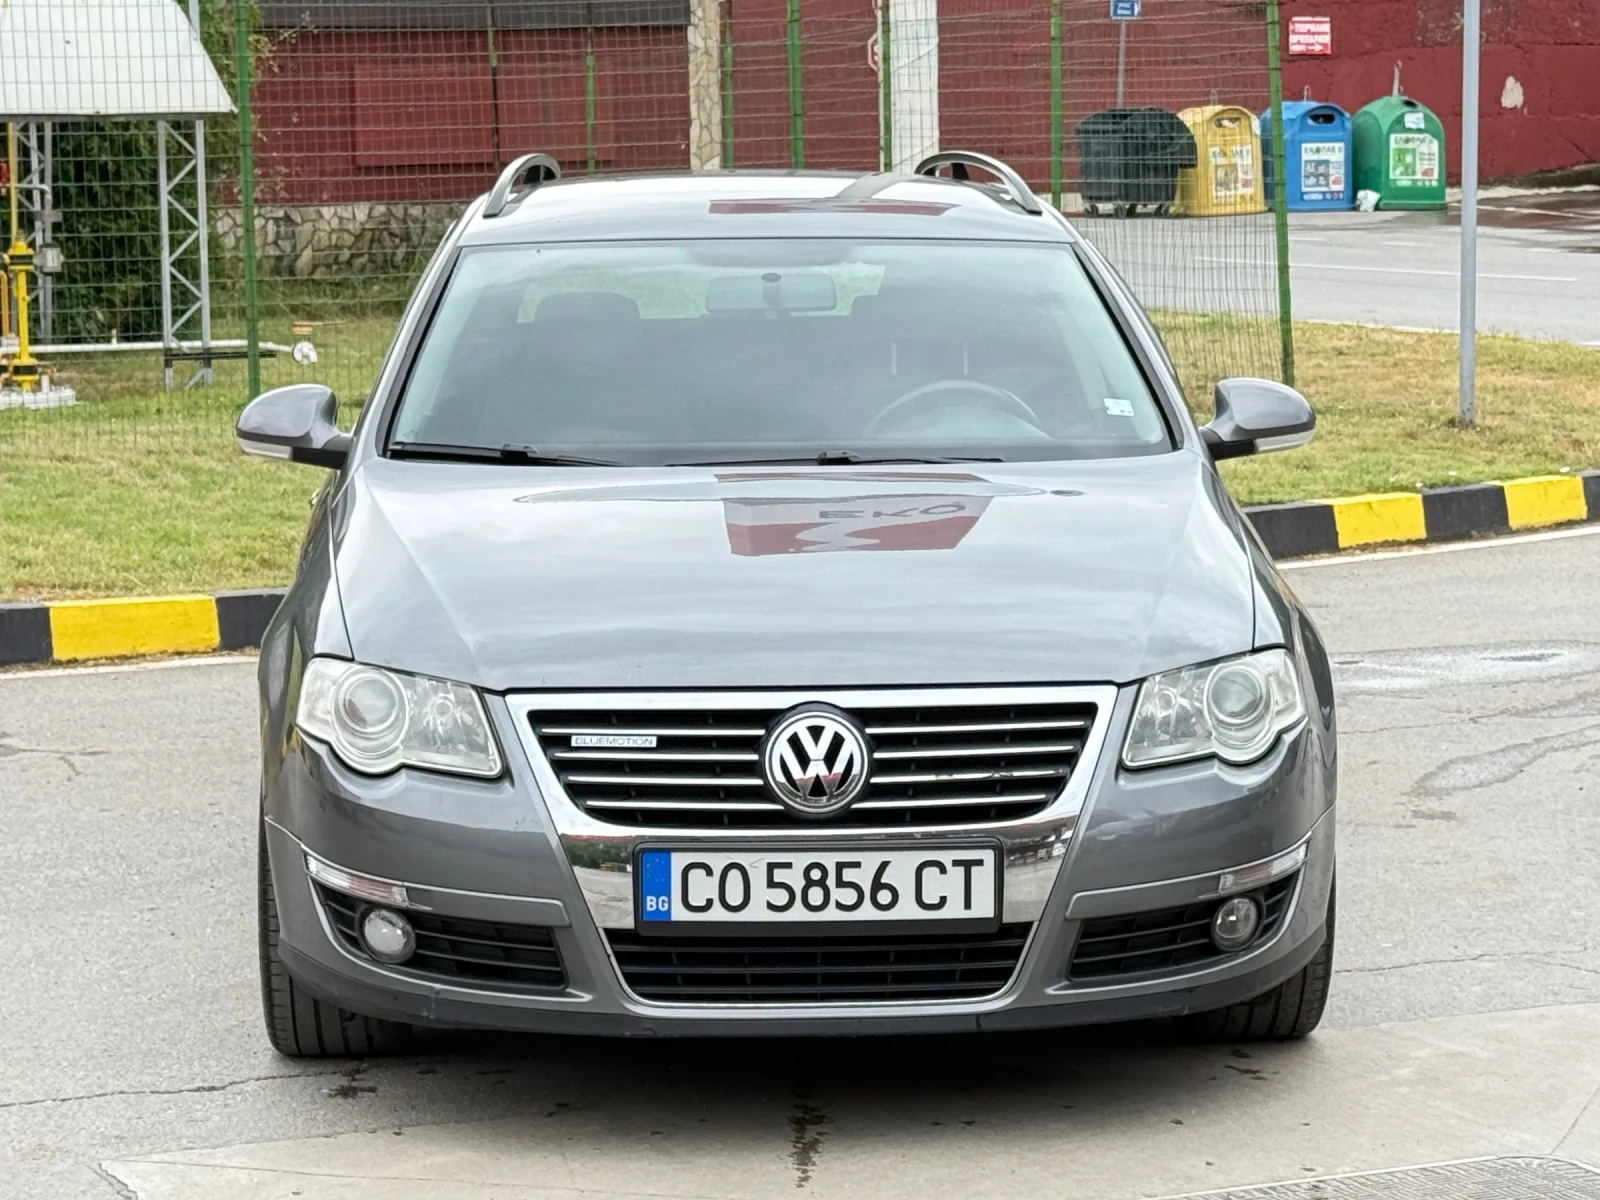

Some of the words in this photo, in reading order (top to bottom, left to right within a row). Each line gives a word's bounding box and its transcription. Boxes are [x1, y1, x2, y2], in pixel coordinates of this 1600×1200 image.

[575, 736, 653, 746] BLUEMOTION
[765, 860, 900, 913] 5856
[645, 895, 670, 912] BG
